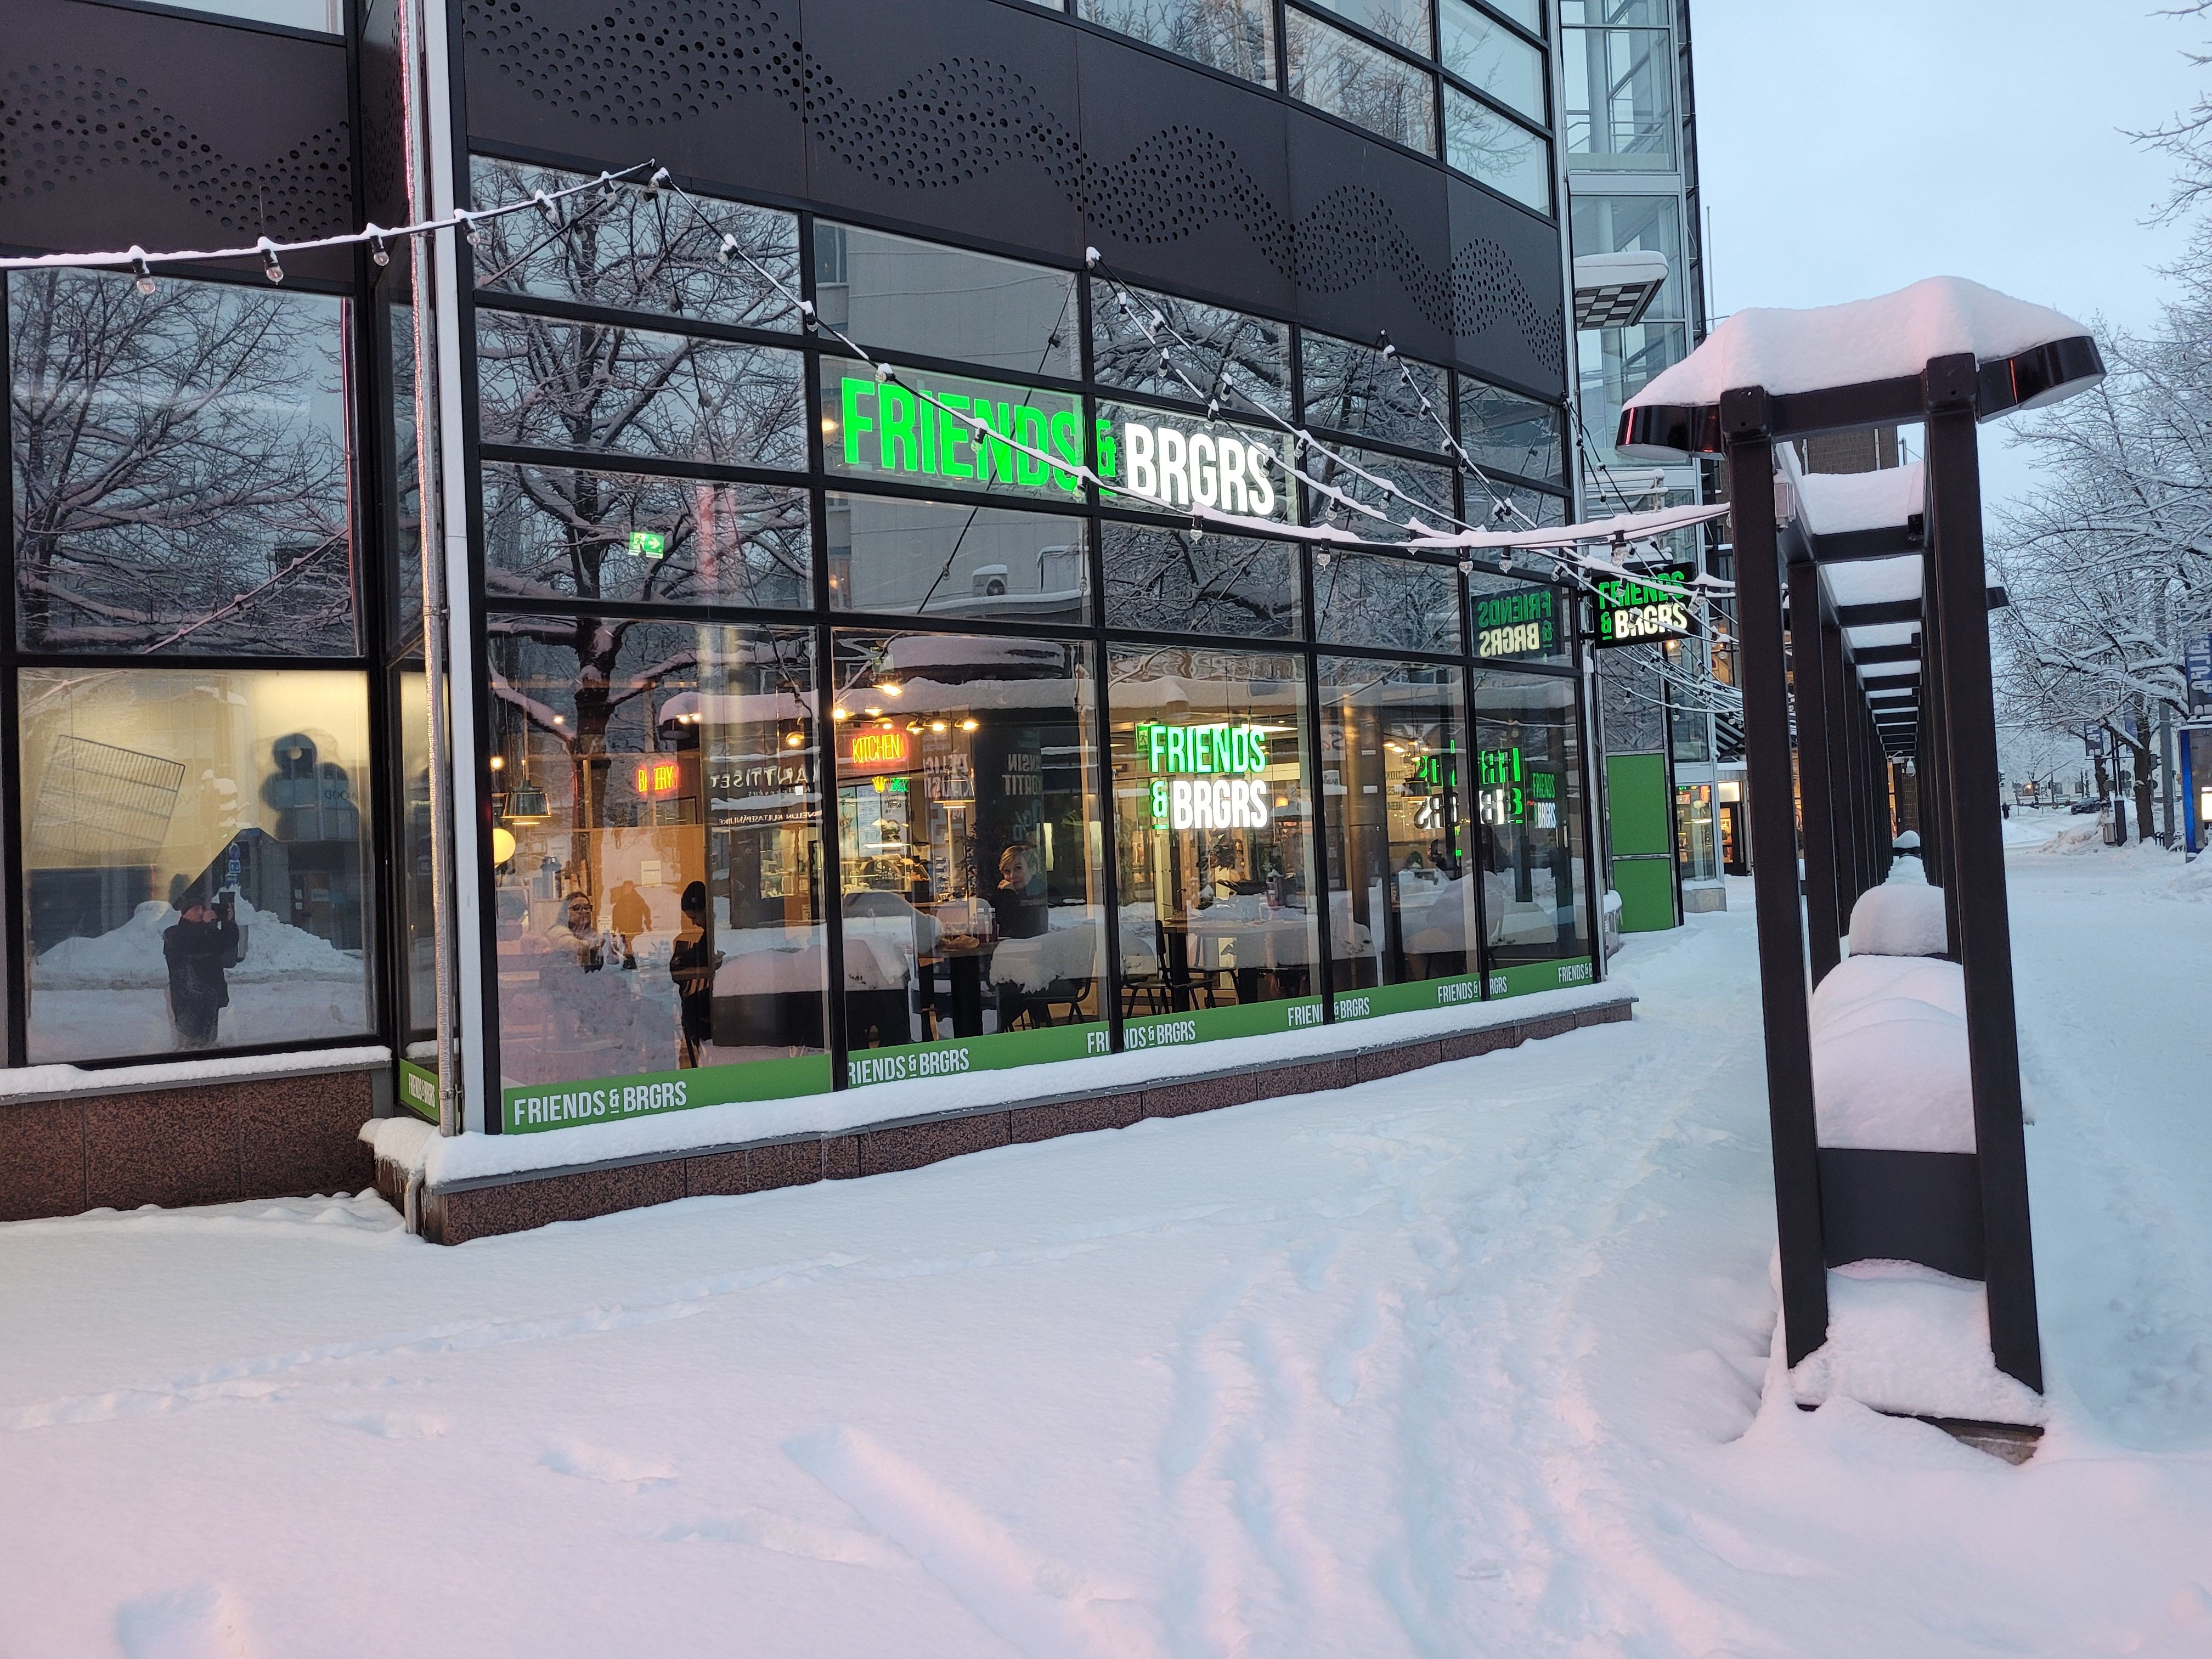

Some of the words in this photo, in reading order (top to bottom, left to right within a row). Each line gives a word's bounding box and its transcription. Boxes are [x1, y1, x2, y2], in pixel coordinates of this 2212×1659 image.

[840, 376, 1079, 492] FRIENDS
[1125, 421, 1276, 516] BRGRS
[1598, 571, 1685, 610] FRIENDS
[1600, 611, 1613, 640] &
[1614, 602, 1688, 639] BRGRS
[852, 733, 900, 764] KITCHEN
[1149, 725, 1267, 773] FRIENDS
[638, 765, 674, 792] BERY
[1532, 772, 1555, 799] FRIENDS
[1150, 781, 1169, 830] &
[1172, 779, 1268, 830] BRGRS
[1537, 802, 1556, 829] BRGRS
[1437, 981, 1473, 1004] FRIENDS
[1479, 976, 1508, 997] RGRS
[1558, 963, 1585, 983] FRIENDS
[1288, 1003, 1324, 1027] FRIEN
[1340, 997, 1370, 1019] BRGRS
[1087, 1026, 1147, 1054] FRINDS
[1156, 1020, 1196, 1045] BRGRS
[848, 1055, 906, 1085] RIENDS
[919, 1048, 969, 1076] BRGRS
[514, 1090, 606, 1125] FRIENDS
[609, 1088, 620, 1114] &
[623, 1081, 687, 1113] BRGRS
